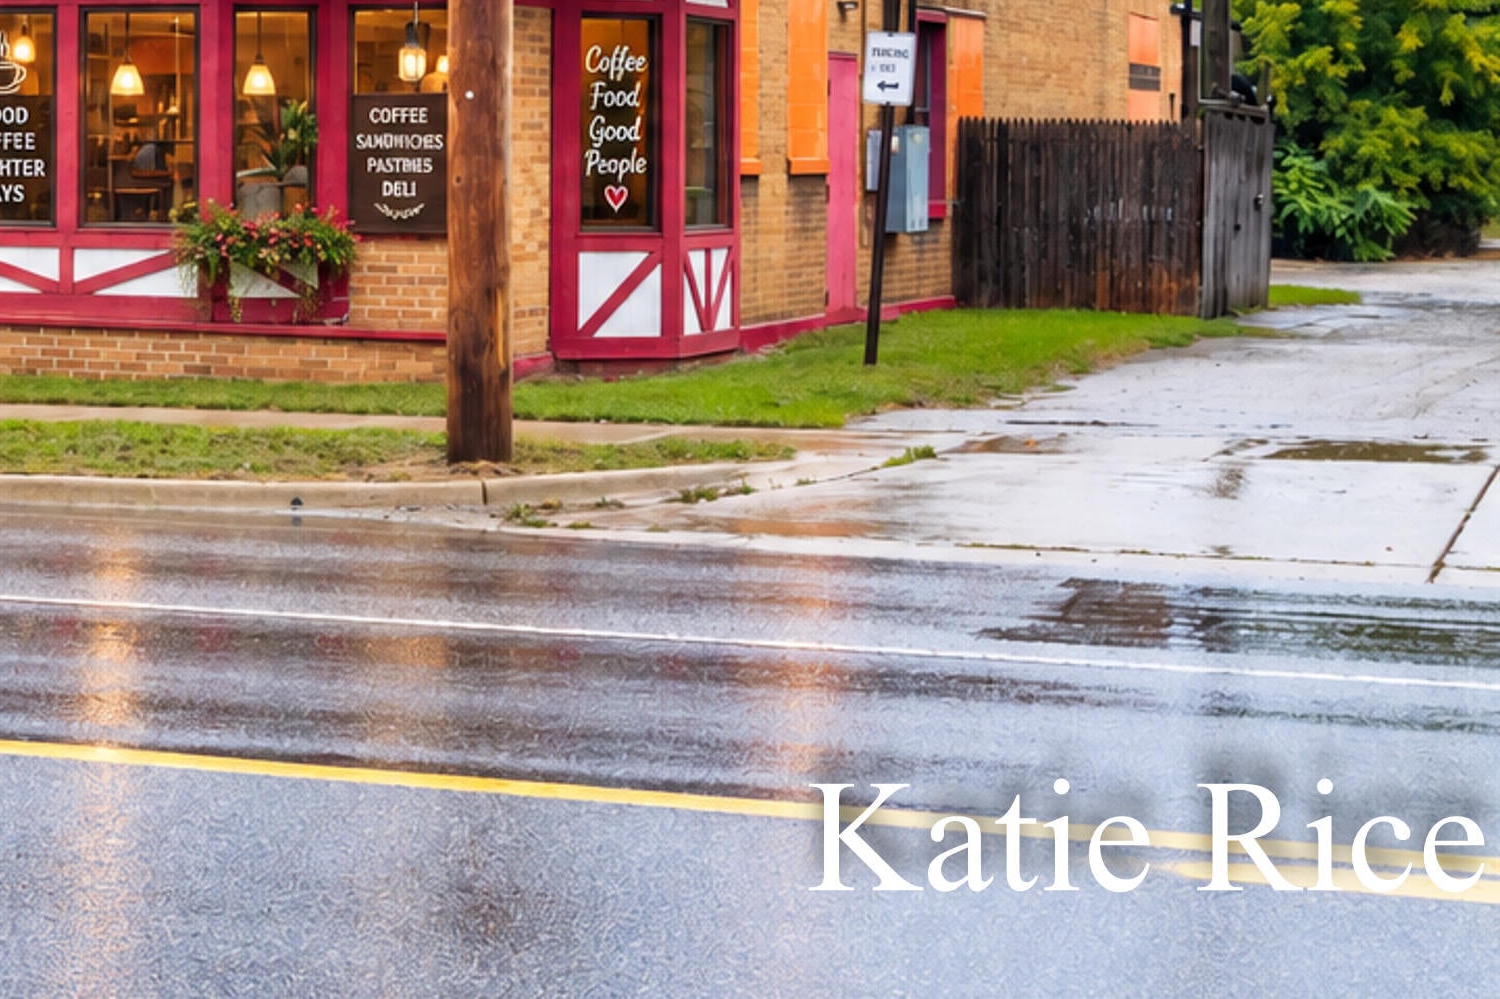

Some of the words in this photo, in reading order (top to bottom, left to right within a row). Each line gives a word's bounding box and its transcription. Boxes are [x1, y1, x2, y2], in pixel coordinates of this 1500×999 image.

[585, 45, 647, 81] Coffee
[589, 81, 640, 110] Food
[369, 107, 428, 124] COFFEE
[589, 115, 641, 147] Good
[584, 148, 647, 183] People
[382, 181, 417, 197] DELI
